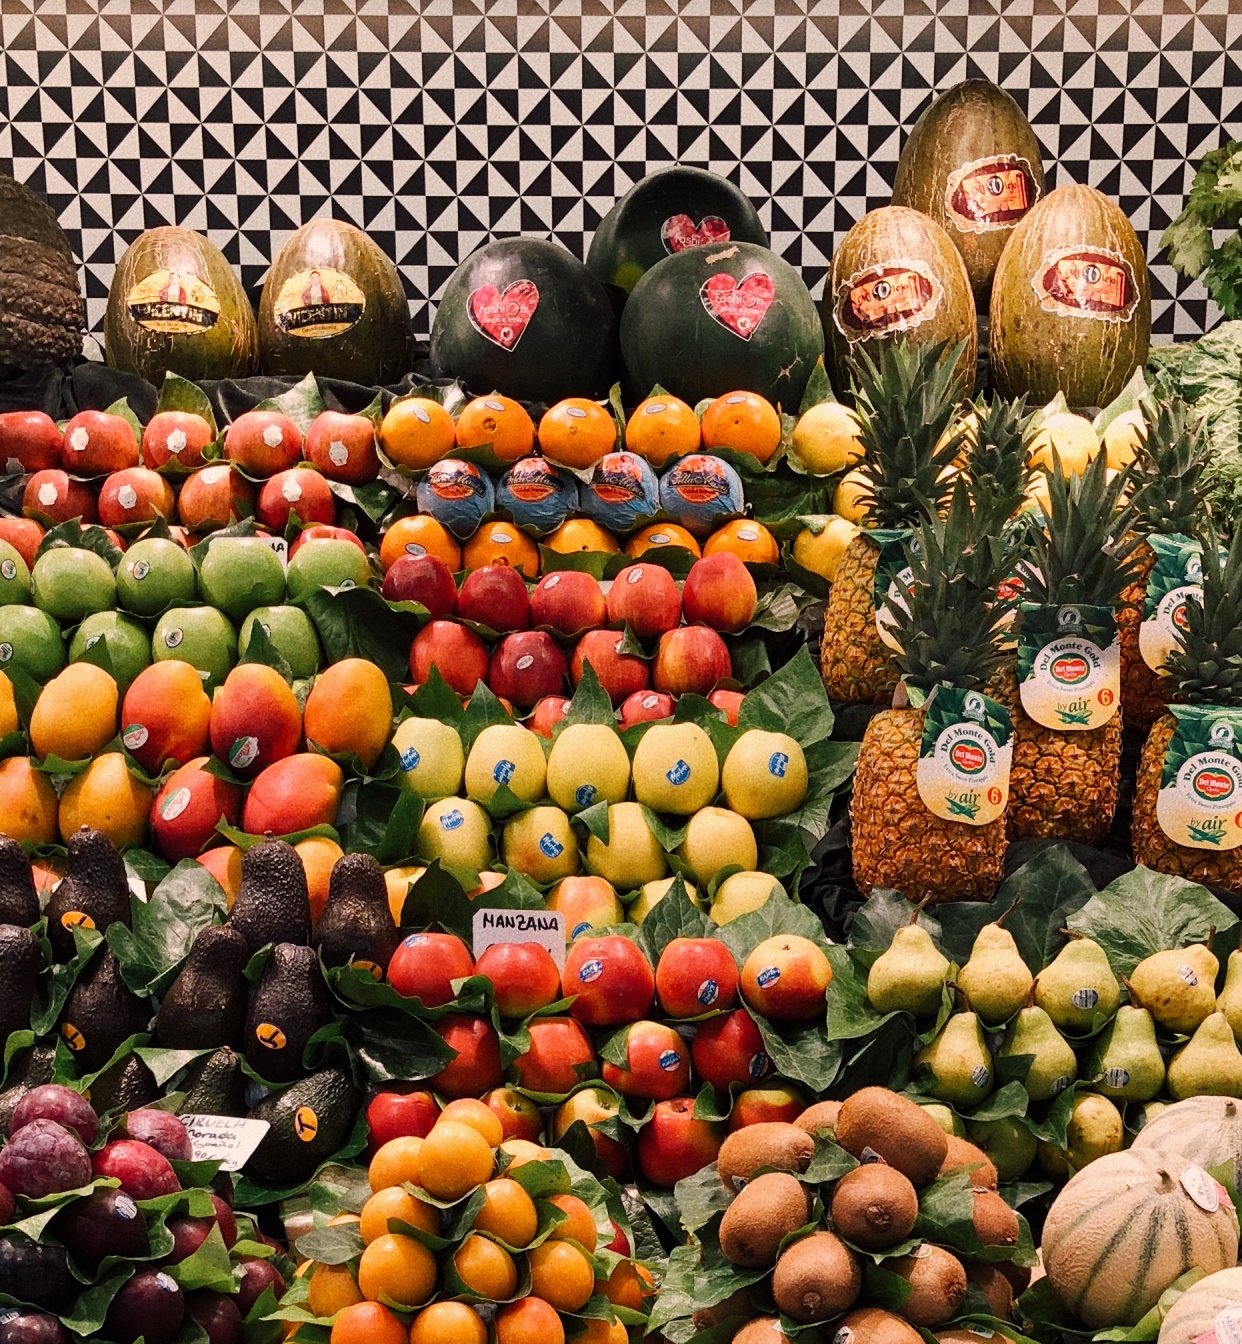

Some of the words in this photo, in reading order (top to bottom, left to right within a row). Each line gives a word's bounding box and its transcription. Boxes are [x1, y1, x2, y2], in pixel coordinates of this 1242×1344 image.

[1040, 654, 1051, 671] Del
[1050, 643, 1082, 655] Monte
[1084, 646, 1101, 668] Gold
[1055, 665, 1065, 673] Del
[1057, 701, 1067, 711] by
[1069, 697, 1091, 712] air
[1102, 690, 1110, 704] 6
[941, 734, 953, 752] Del
[954, 728, 983, 740] Monte
[984, 738, 996, 763] Gold
[955, 750, 965, 758] Del
[965, 752, 983, 763] Monte
[1184, 763, 1197, 781] Del
[1198, 756, 1231, 767] Monte
[1210, 780, 1230, 789] Monte
[949, 790, 958, 800] by
[959, 789, 981, 804] air
[991, 789, 999, 804] 6
[1191, 818, 1201, 826] by
[1202, 816, 1227, 830] air
[482, 912, 559, 931] MANZANA
